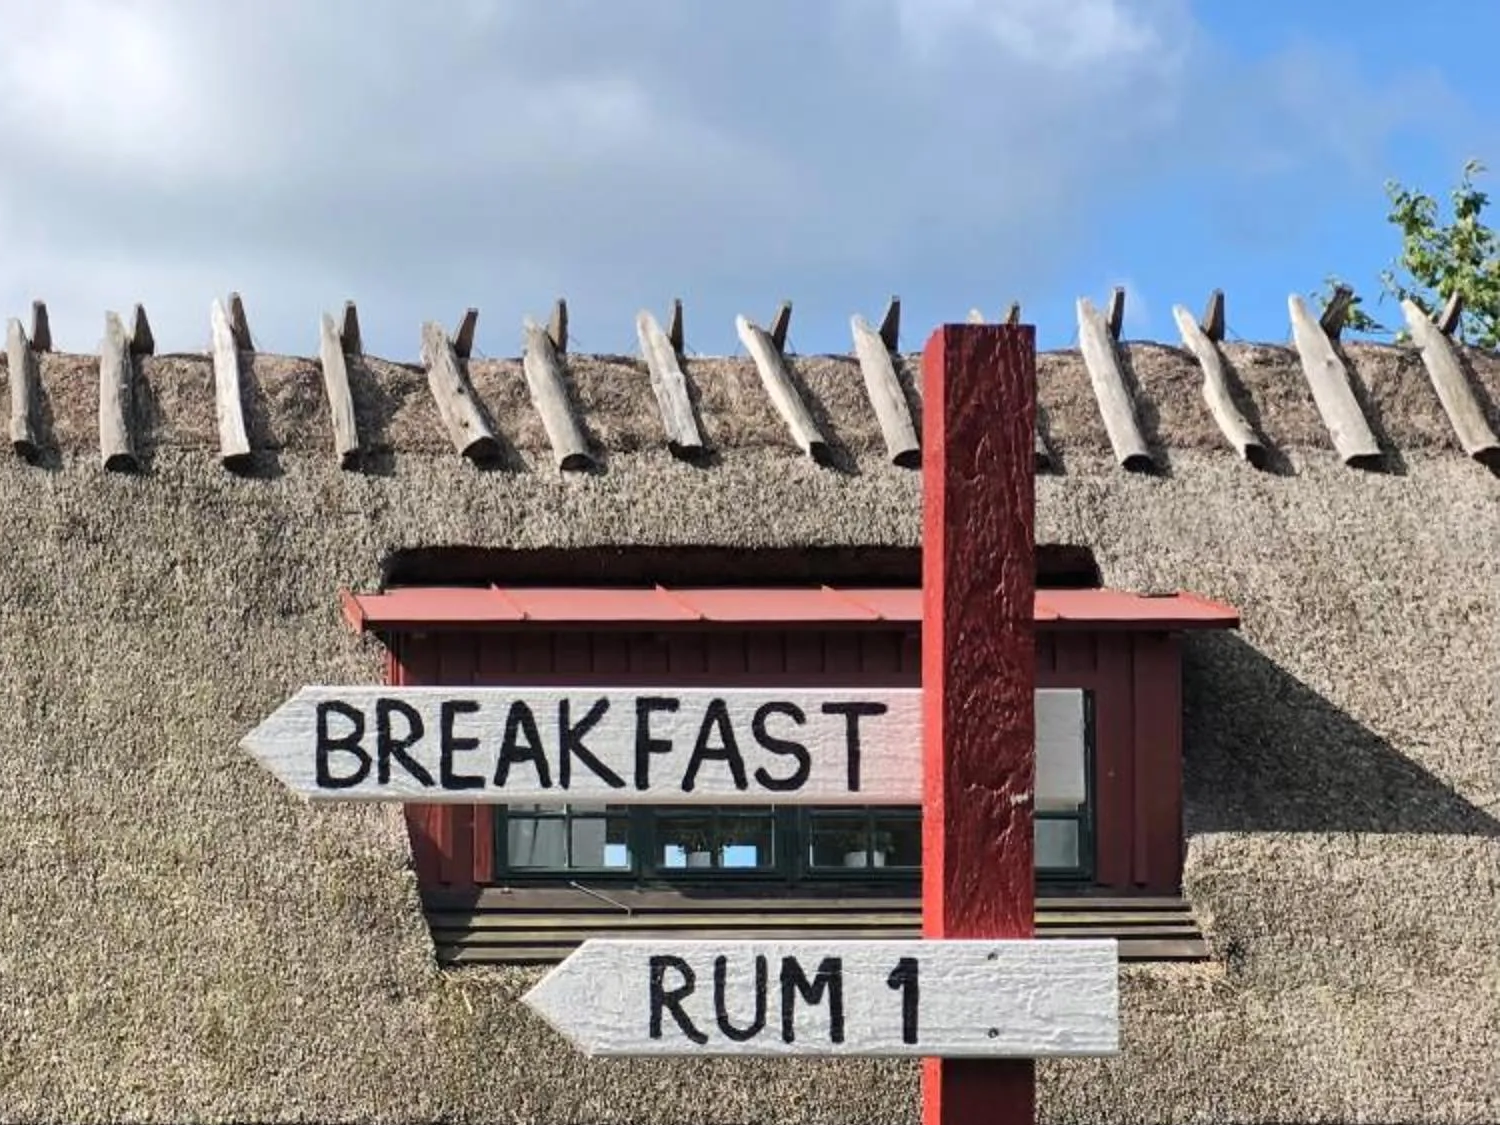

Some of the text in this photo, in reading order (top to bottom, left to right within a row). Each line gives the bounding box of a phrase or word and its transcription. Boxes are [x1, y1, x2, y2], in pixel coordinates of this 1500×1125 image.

[314, 696, 889, 793] BREAKFAST
[648, 953, 921, 1045] RUM 1
